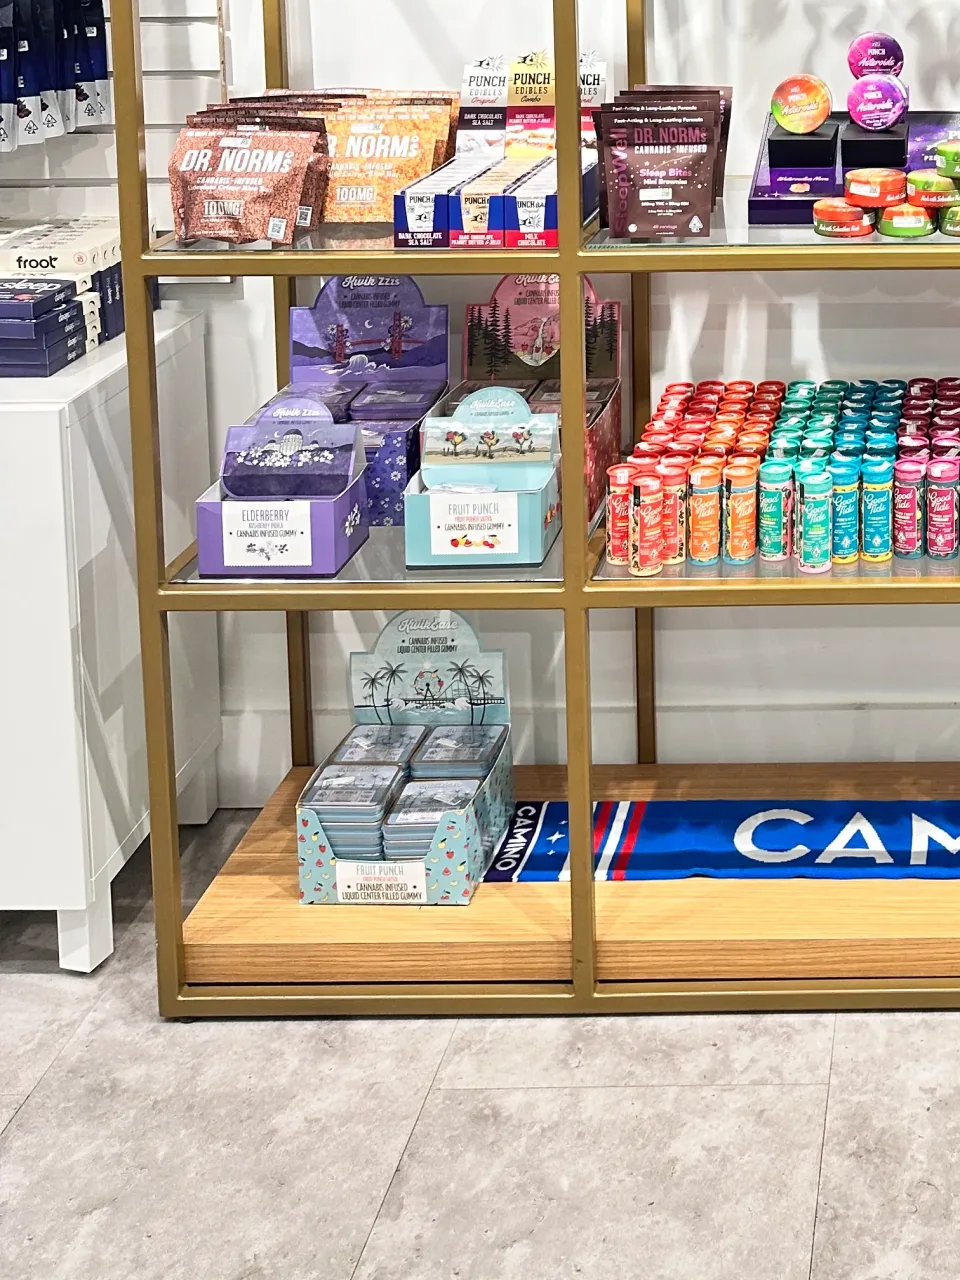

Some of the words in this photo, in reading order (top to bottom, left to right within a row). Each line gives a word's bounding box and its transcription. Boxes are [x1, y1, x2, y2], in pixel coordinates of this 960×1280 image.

[867, 48, 886, 56] PUNCH
[857, 56, 896, 68] Asteroids
[468, 75, 506, 87] PUNCH
[513, 72, 551, 85] PUNCH
[469, 88, 503, 97] EDIBLES
[515, 86, 548, 95] EDIBLES
[863, 91, 883, 99] PUNCH
[470, 96, 497, 104] Original
[520, 94, 541, 103] Combo
[781, 101, 819, 116] Asteroids
[856, 100, 893, 112] Asteroids
[634, 127, 657, 144] DR.
[180, 150, 213, 172] DR.
[639, 168, 666, 178] Sleep
[668, 167, 693, 177] Bites
[335, 186, 375, 202] 100MG
[408, 195, 431, 204] PUNCH
[464, 196, 486, 205] PUNCH
[203, 200, 243, 217] 100MG
[414, 232, 443, 240] CHOCOLATE
[16, 254, 59, 269] froot
[342, 275, 377, 289] Kwik
[469, 398, 516, 409] KwikEase
[272, 406, 301, 419] Kwik
[448, 503, 470, 516] FRUIT
[472, 502, 499, 515] PUNCH
[242, 509, 290, 522] ELDERBERRY
[444, 523, 467, 531] CANNABIS
[468, 523, 486, 531] INFUSED
[486, 522, 505, 530] GUMMY
[236, 529, 259, 538] CANNABIS
[260, 529, 279, 537] INFUSED
[280, 529, 298, 537] GUMMY
[397, 616, 459, 633] KwikEase
[408, 636, 430, 645] CANNABIS
[430, 636, 448, 645] INFUSED
[396, 645, 411, 654] LIQUID
[411, 645, 426, 653] CENTER
[440, 644, 458, 653] GUMMY
[495, 805, 535, 871] CAMINO
[356, 864, 376, 876] FRUIT
[378, 865, 404, 876] PUNCH
[356, 883, 385, 892] CANNABIS
[385, 883, 408, 892] INFUSED
[342, 892, 360, 901] LIQUID
[360, 892, 381, 901] CENTER
[381, 891, 400, 901] FILLED
[400, 892, 422, 901] GUMMY
